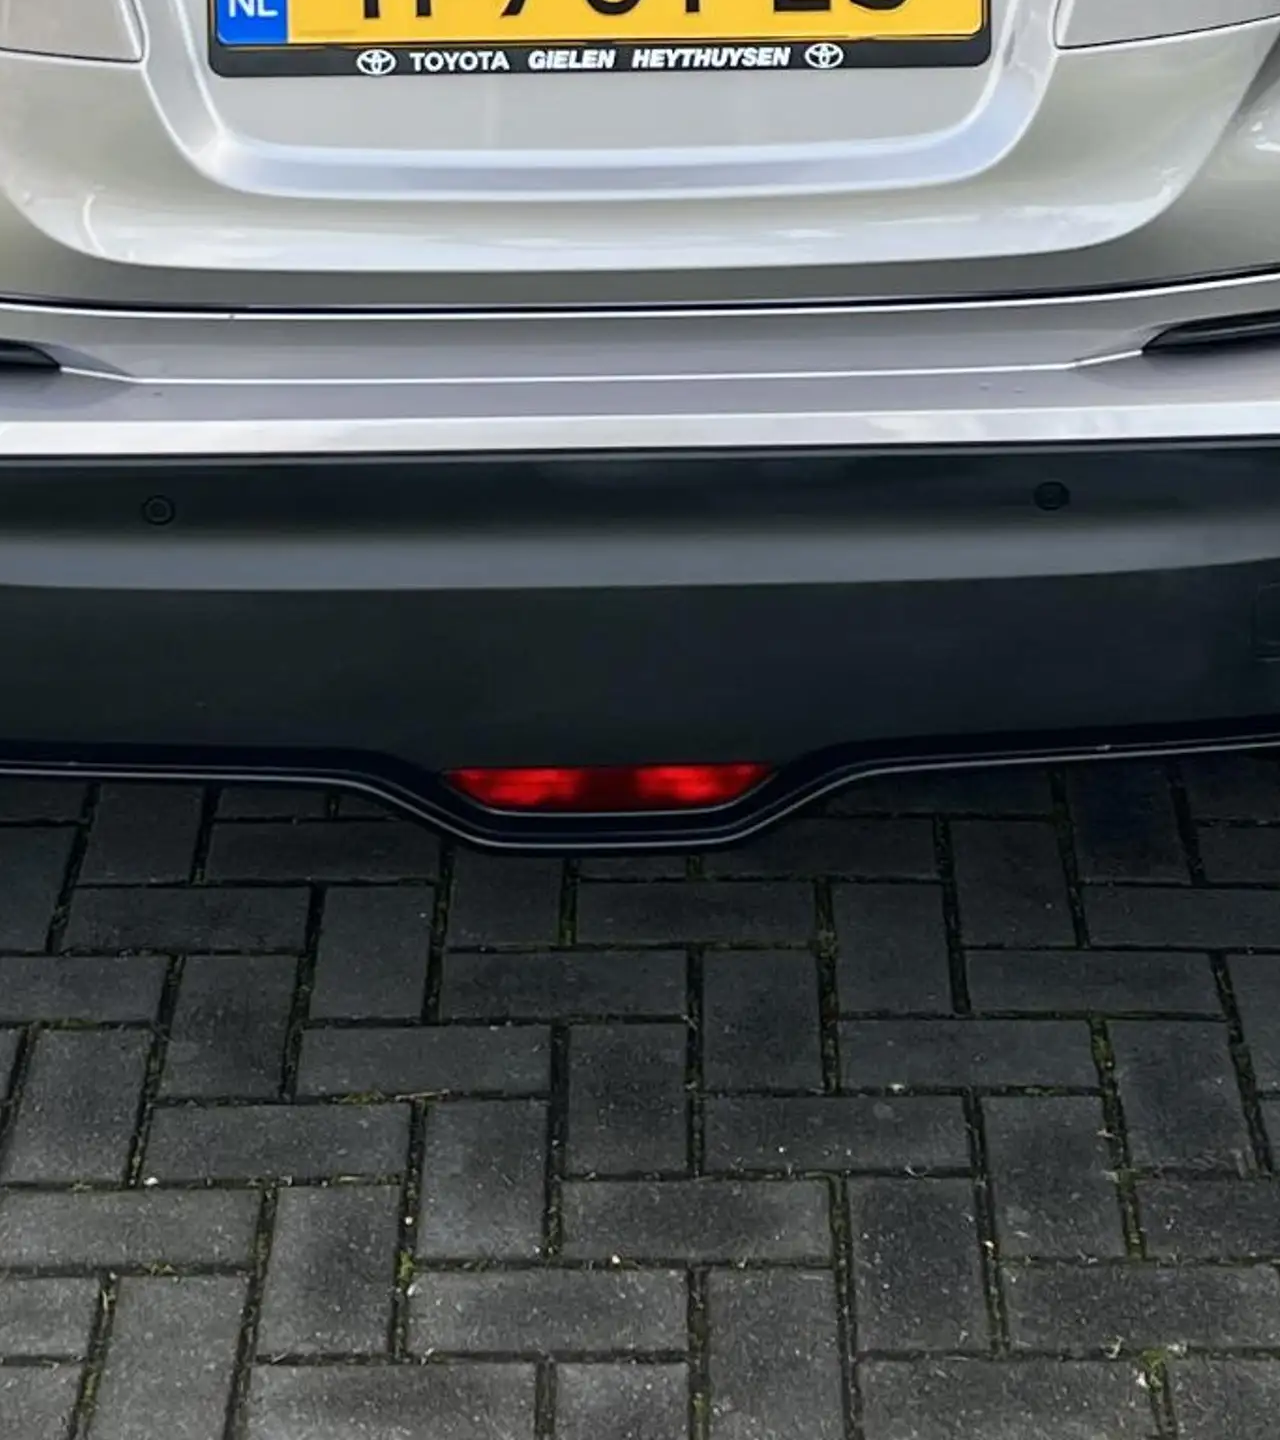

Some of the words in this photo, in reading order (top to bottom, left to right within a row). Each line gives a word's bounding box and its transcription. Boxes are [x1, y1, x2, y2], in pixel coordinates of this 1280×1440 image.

[409, 50, 511, 72] TOYOTA
[527, 49, 617, 70] GIELEN
[630, 46, 792, 69] HEYTHUYSEN
